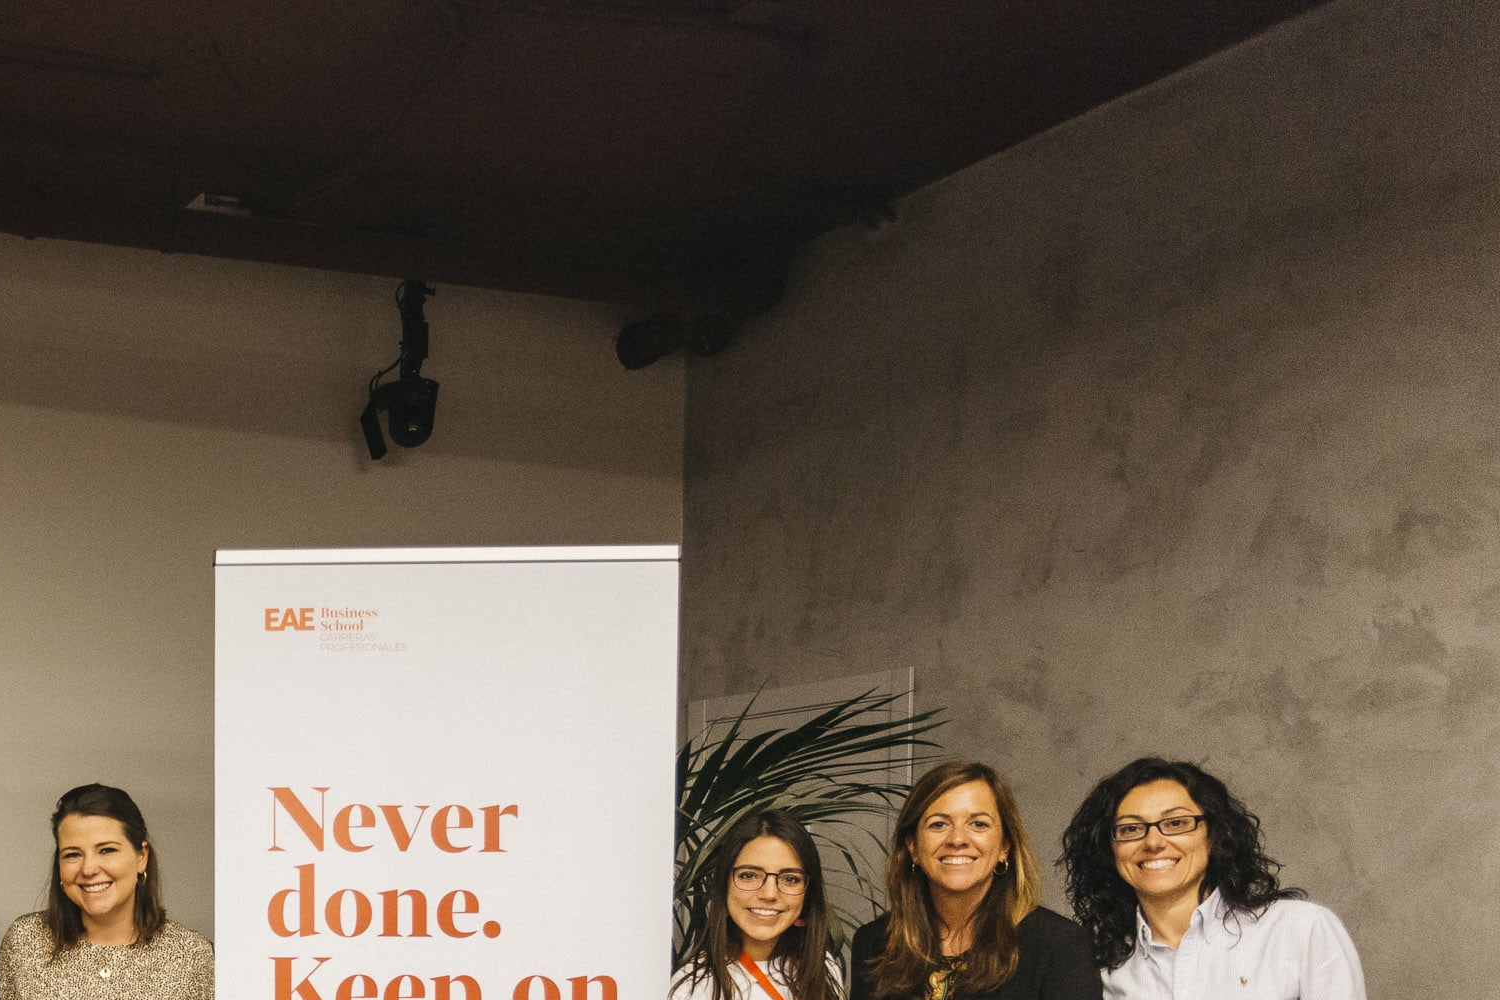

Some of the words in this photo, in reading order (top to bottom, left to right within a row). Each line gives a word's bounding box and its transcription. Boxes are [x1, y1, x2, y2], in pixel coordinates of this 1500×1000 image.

[320, 607, 378, 618] Business
[264, 608, 315, 631] EAE
[320, 619, 364, 631] School
[319, 632, 376, 642] CARRERAS
[319, 642, 408, 652] PROFESIONALES
[267, 786, 519, 853] Never
[267, 863, 502, 939] done.
